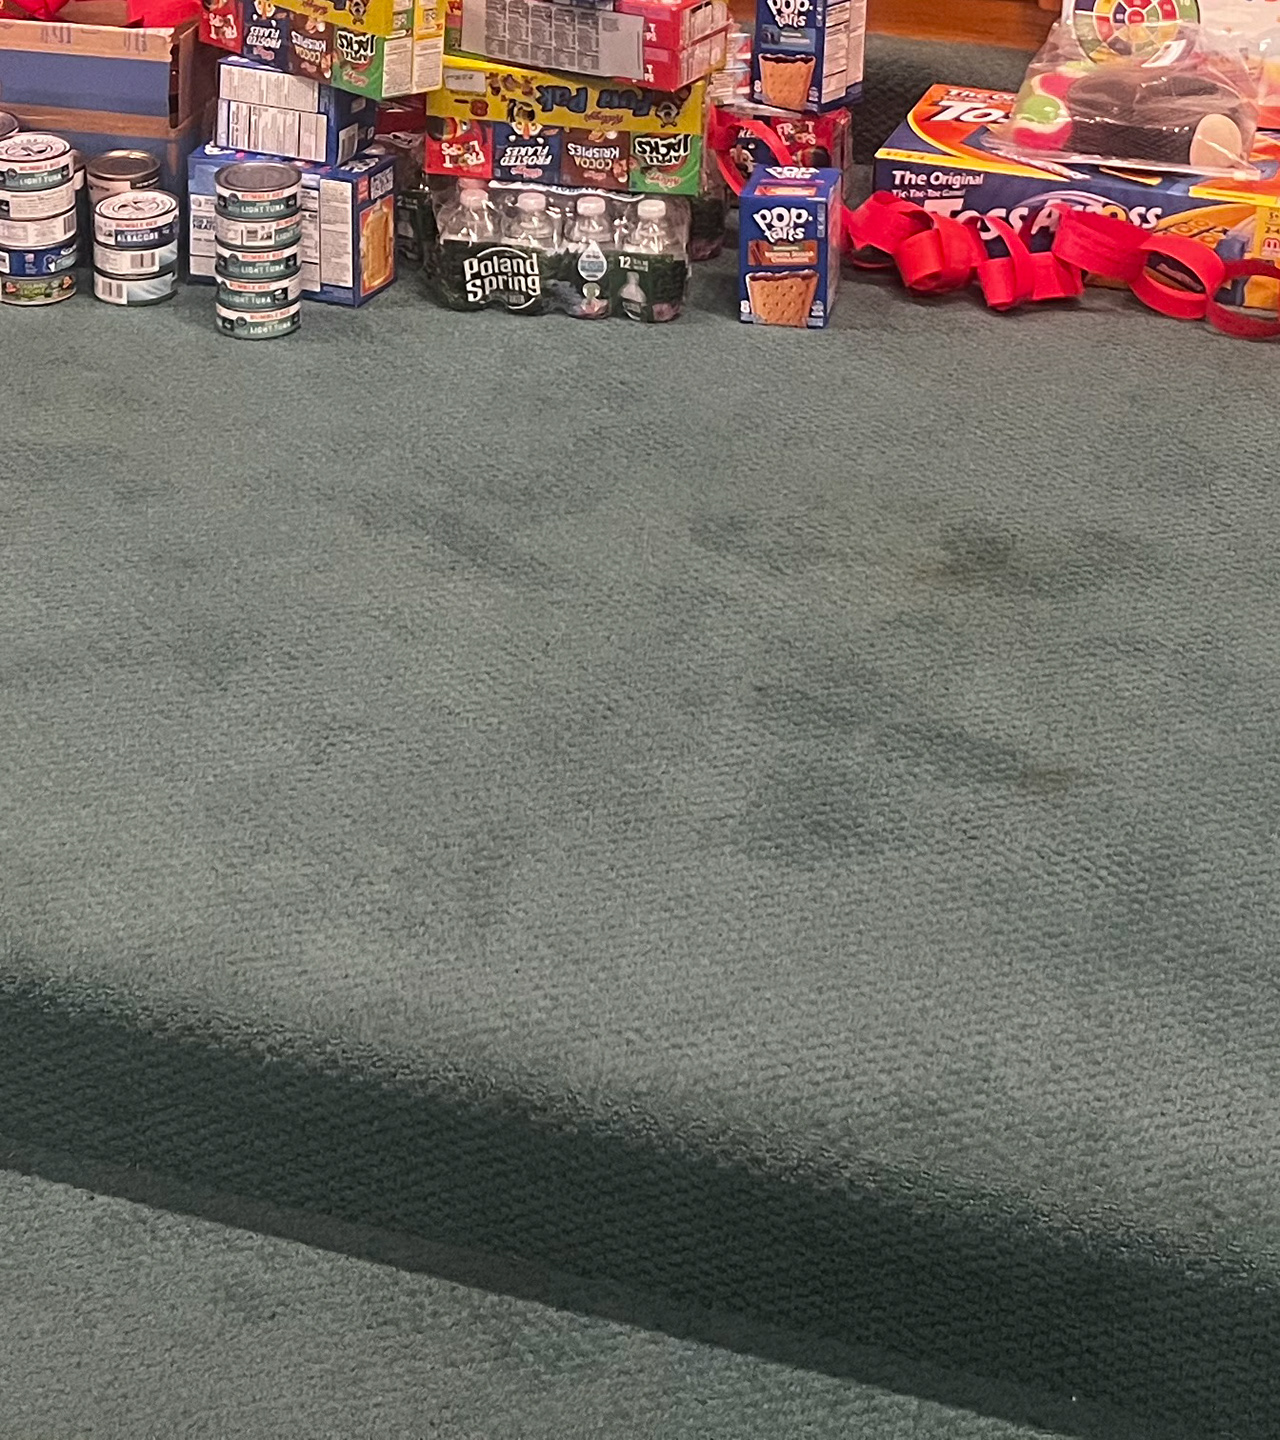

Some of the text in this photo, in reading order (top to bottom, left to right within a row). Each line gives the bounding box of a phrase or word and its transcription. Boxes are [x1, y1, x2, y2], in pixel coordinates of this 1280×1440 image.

[249, 25, 280, 38] FLAKES
[246, 35, 282, 49] FROSTED
[291, 31, 326, 52] KRISPIES
[336, 31, 377, 57] JACKS
[534, 84, 654, 116] Fun Pak
[504, 144, 550, 158] FLAKES
[566, 142, 620, 159] KRISPIES
[633, 132, 692, 158] JACKS
[499, 153, 553, 167] FROSTED
[574, 156, 613, 169] COCOA
[892, 170, 984, 189] The Original
[763, 226, 806, 244] tarts
[462, 251, 540, 281] Poland
[618, 255, 632, 269] 12
[465, 273, 541, 303] Spring
